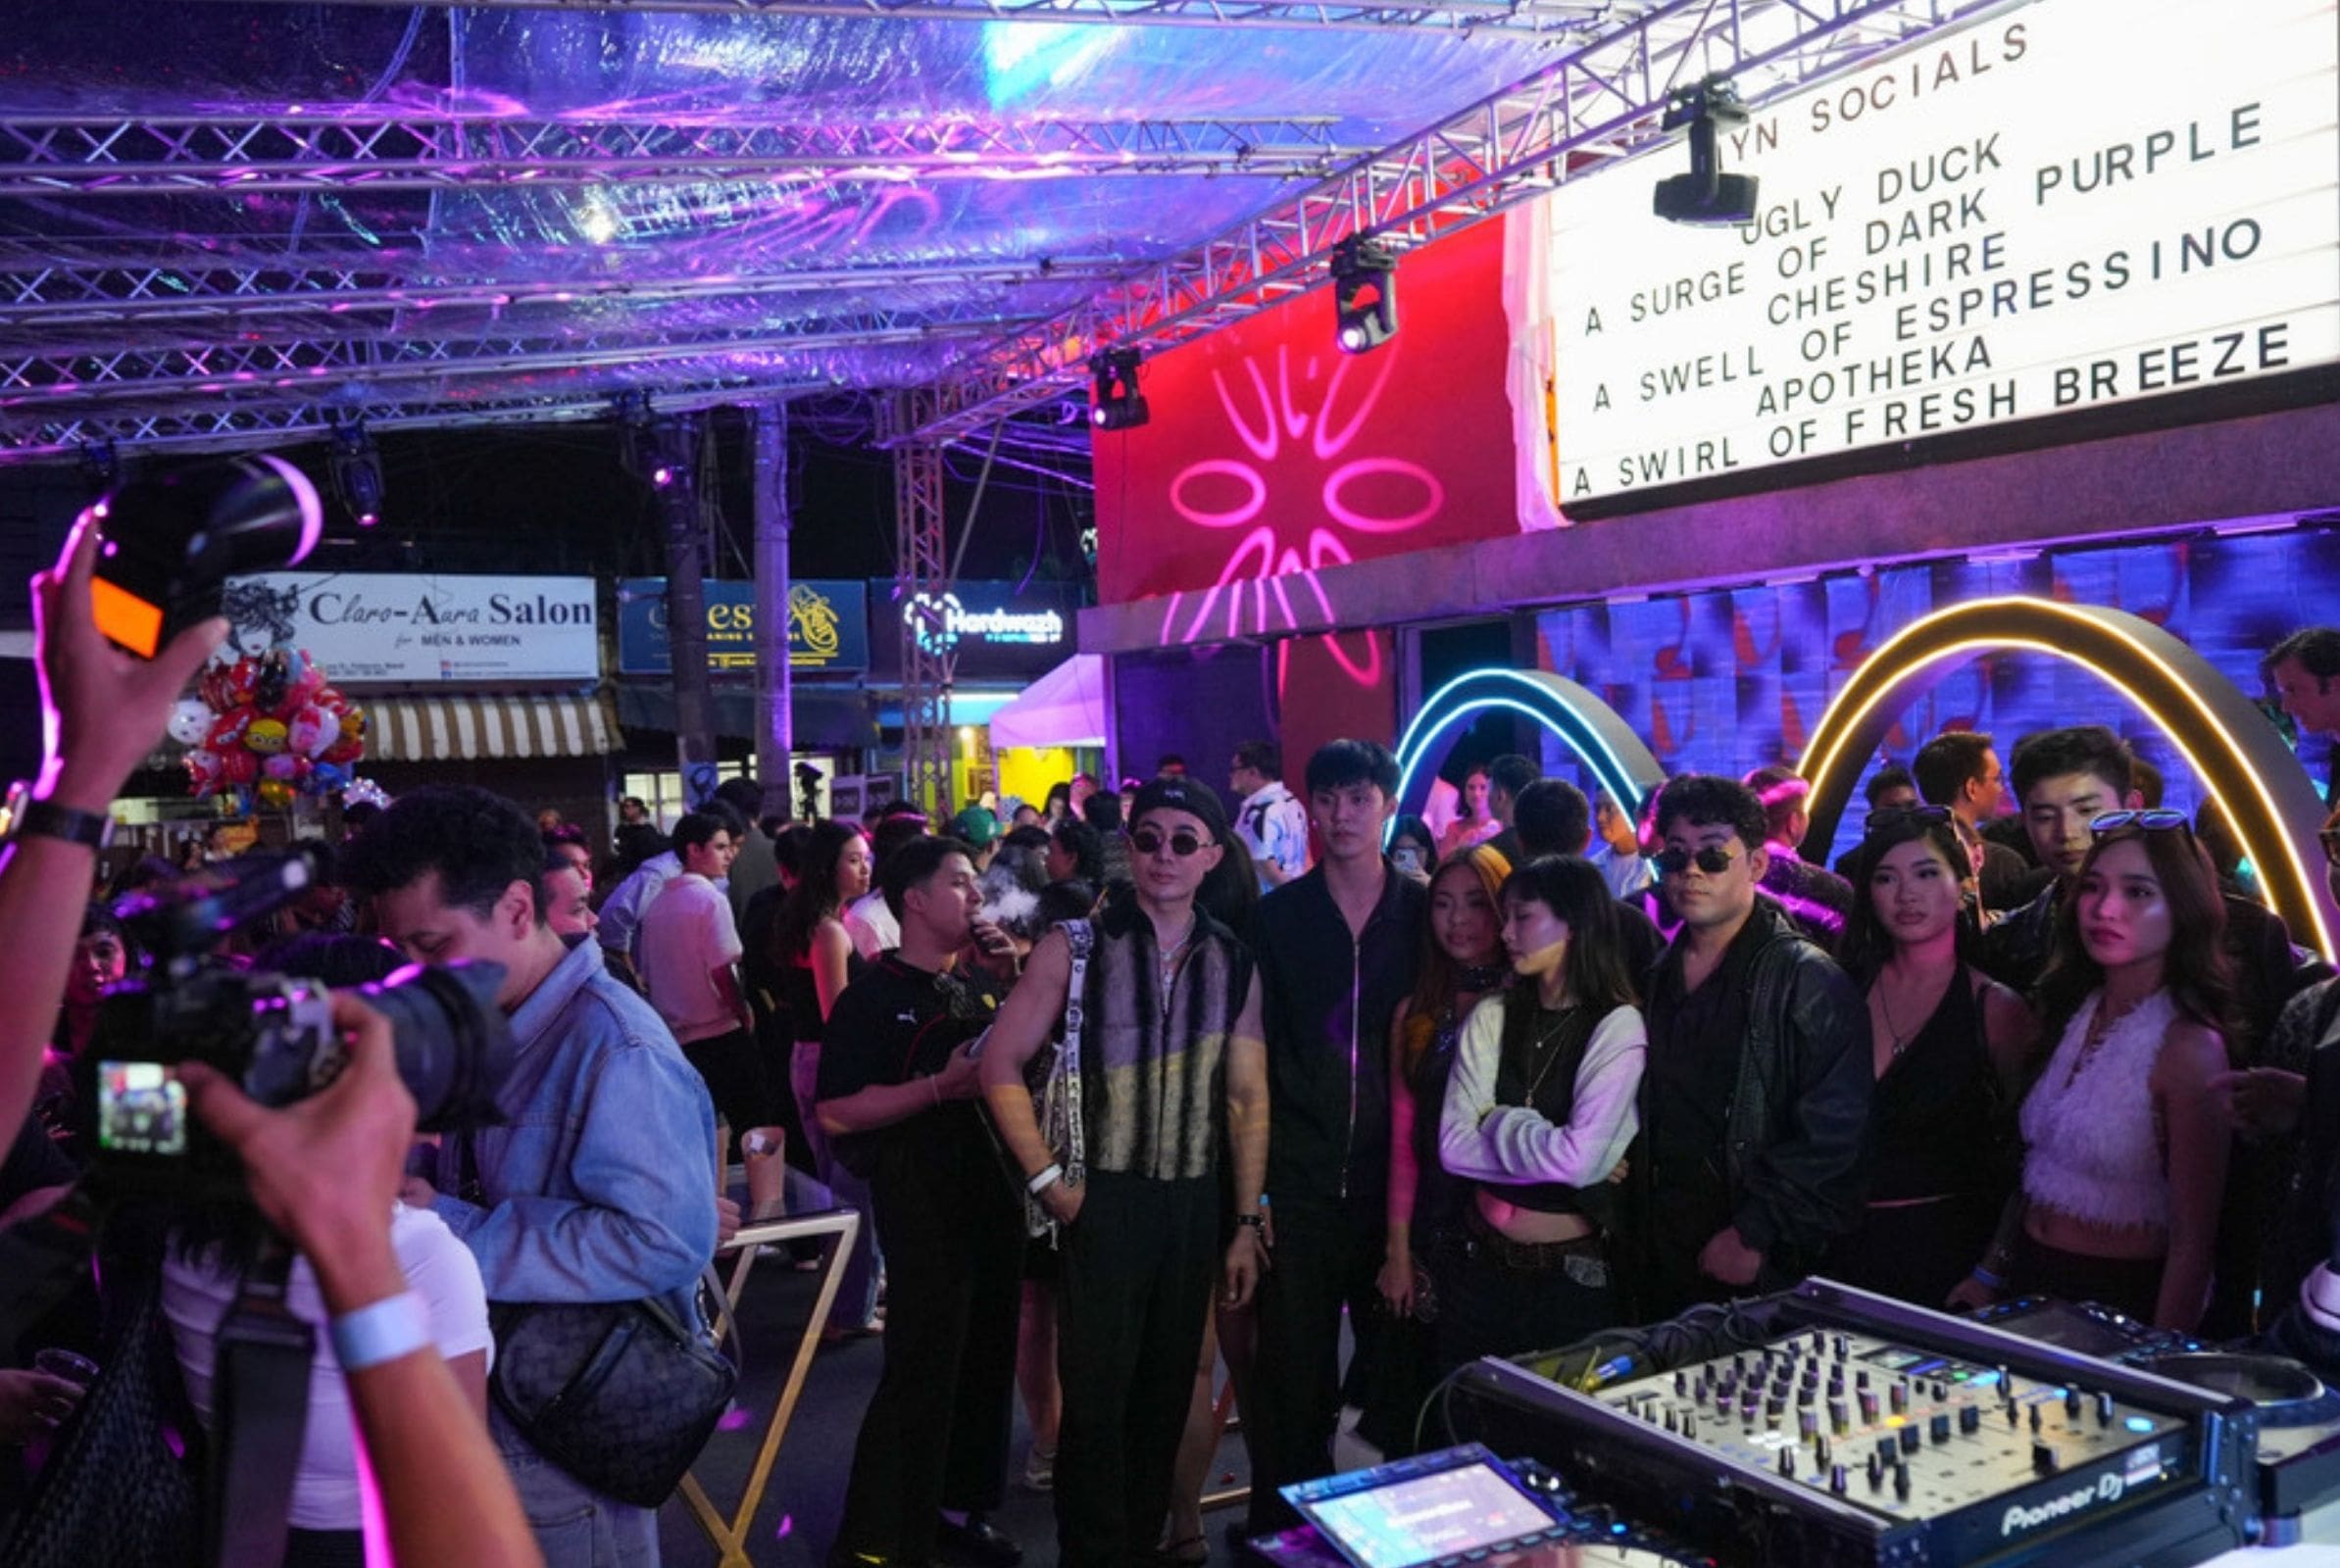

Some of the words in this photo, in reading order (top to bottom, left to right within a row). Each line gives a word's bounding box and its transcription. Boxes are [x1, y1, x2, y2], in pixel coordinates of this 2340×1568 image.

[1811, 24, 2027, 133] SOCIALS
[1584, 307, 1603, 336] A
[1630, 262, 1746, 322] SURGE
[1777, 236, 1827, 278] OF
[1866, 187, 1987, 256] DARK
[2036, 102, 2262, 206] PURPLE
[1741, 185, 1842, 245] UGLY
[1877, 132, 2002, 204] DUCK
[1593, 383, 1612, 412] A
[1639, 345, 1764, 402] SWELL
[1801, 321, 1852, 362] OF
[1897, 218, 2262, 341] ESPRESSINO
[1767, 231, 2006, 325] CHESHIRE
[1572, 466, 1591, 496] A
[1618, 437, 1739, 486] SWIRL
[1768, 418, 1817, 457] OF
[1847, 379, 2016, 444] FRESH
[2055, 323, 2289, 408] BREEZE
[1756, 335, 1992, 416] APOTHEKA
[421, 634, 452, 647] MEN
[454, 634, 465, 647] &
[469, 634, 521, 647] WOMEN
[488, 594, 592, 625] Salon
[2001, 1485, 2096, 1537] Pioneer
